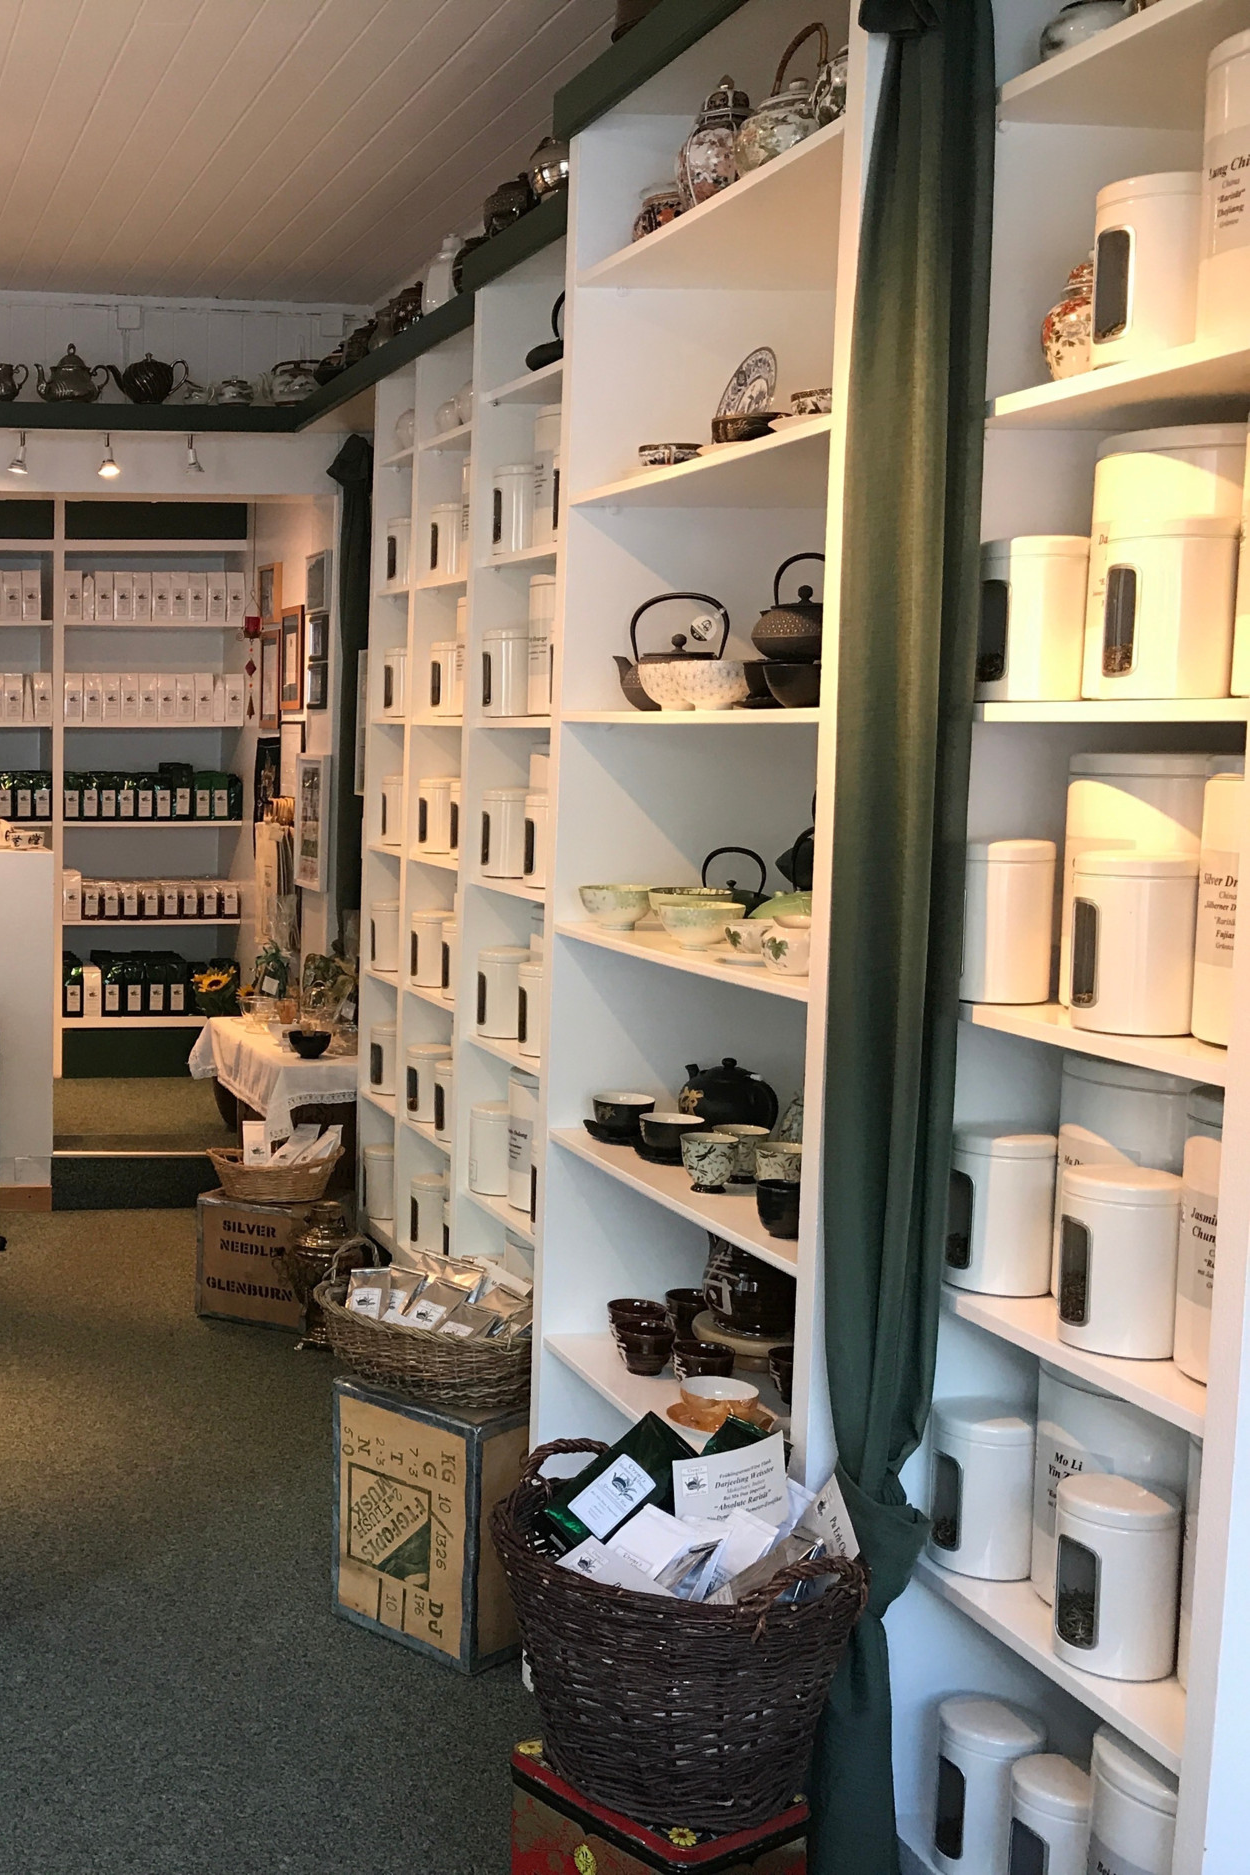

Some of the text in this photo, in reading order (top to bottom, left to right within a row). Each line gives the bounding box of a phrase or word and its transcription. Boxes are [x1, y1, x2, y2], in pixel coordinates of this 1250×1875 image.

[222, 1219, 276, 1238] SILVER
[1192, 1225, 1217, 1247] Chun
[206, 1276, 293, 1302] GLENBURN
[441, 1450, 457, 1485] KG
[1048, 1463, 1061, 1479] Yin
[1054, 1451, 1083, 1471] Mo Li
[714, 1475, 749, 1489] Darjeeling
[351, 1475, 395, 1520] MUSK
[353, 1498, 394, 1539] FLUSH
[386, 1593, 398, 1612] 10
[414, 1593, 425, 1616] 176
